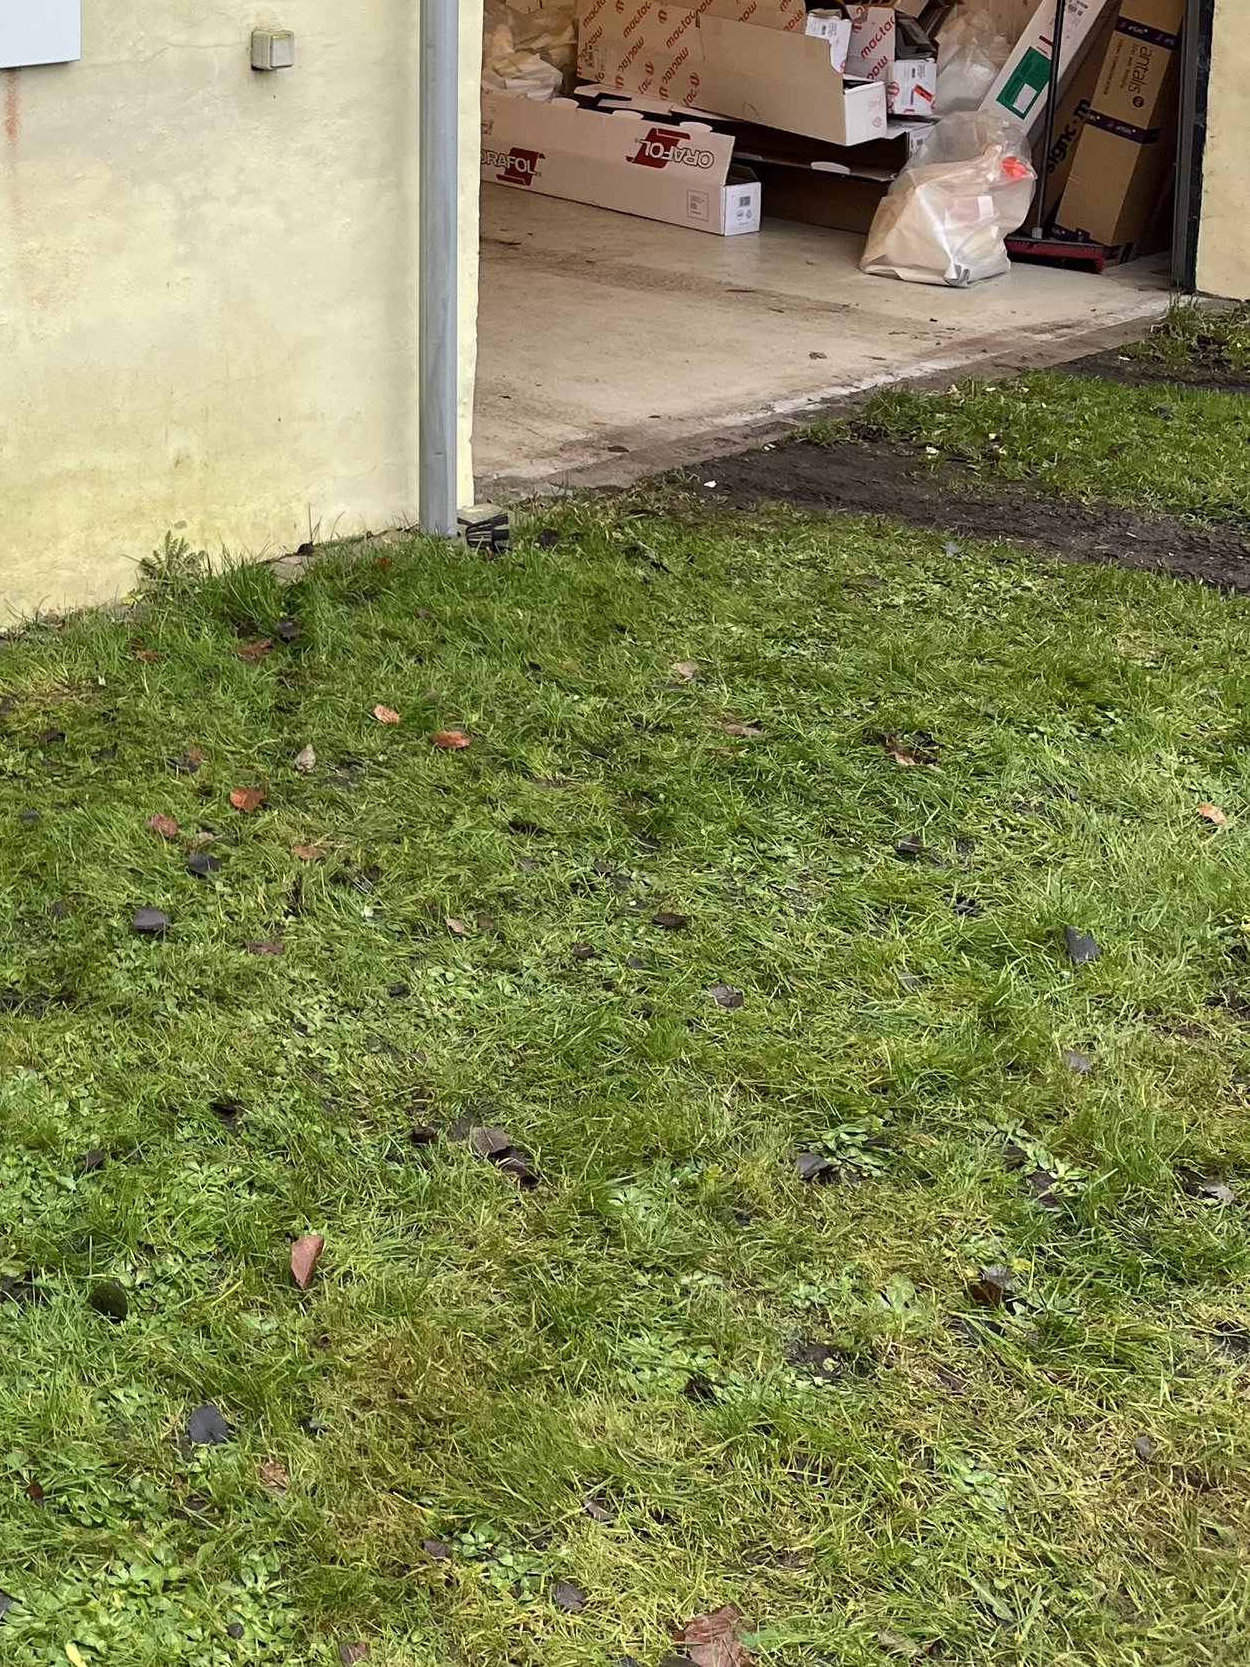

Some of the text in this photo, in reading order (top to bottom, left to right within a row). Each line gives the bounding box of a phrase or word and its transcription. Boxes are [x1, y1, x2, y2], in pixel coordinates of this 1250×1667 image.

[622, 1, 652, 39] mactac
[665, 10, 697, 49] mactac
[617, 36, 645, 74] mactac
[661, 46, 690, 84] mactac
[1127, 45, 1152, 94] antalis
[481, 149, 538, 176] ORAFOL
[637, 138, 715, 169] ORAFOL
